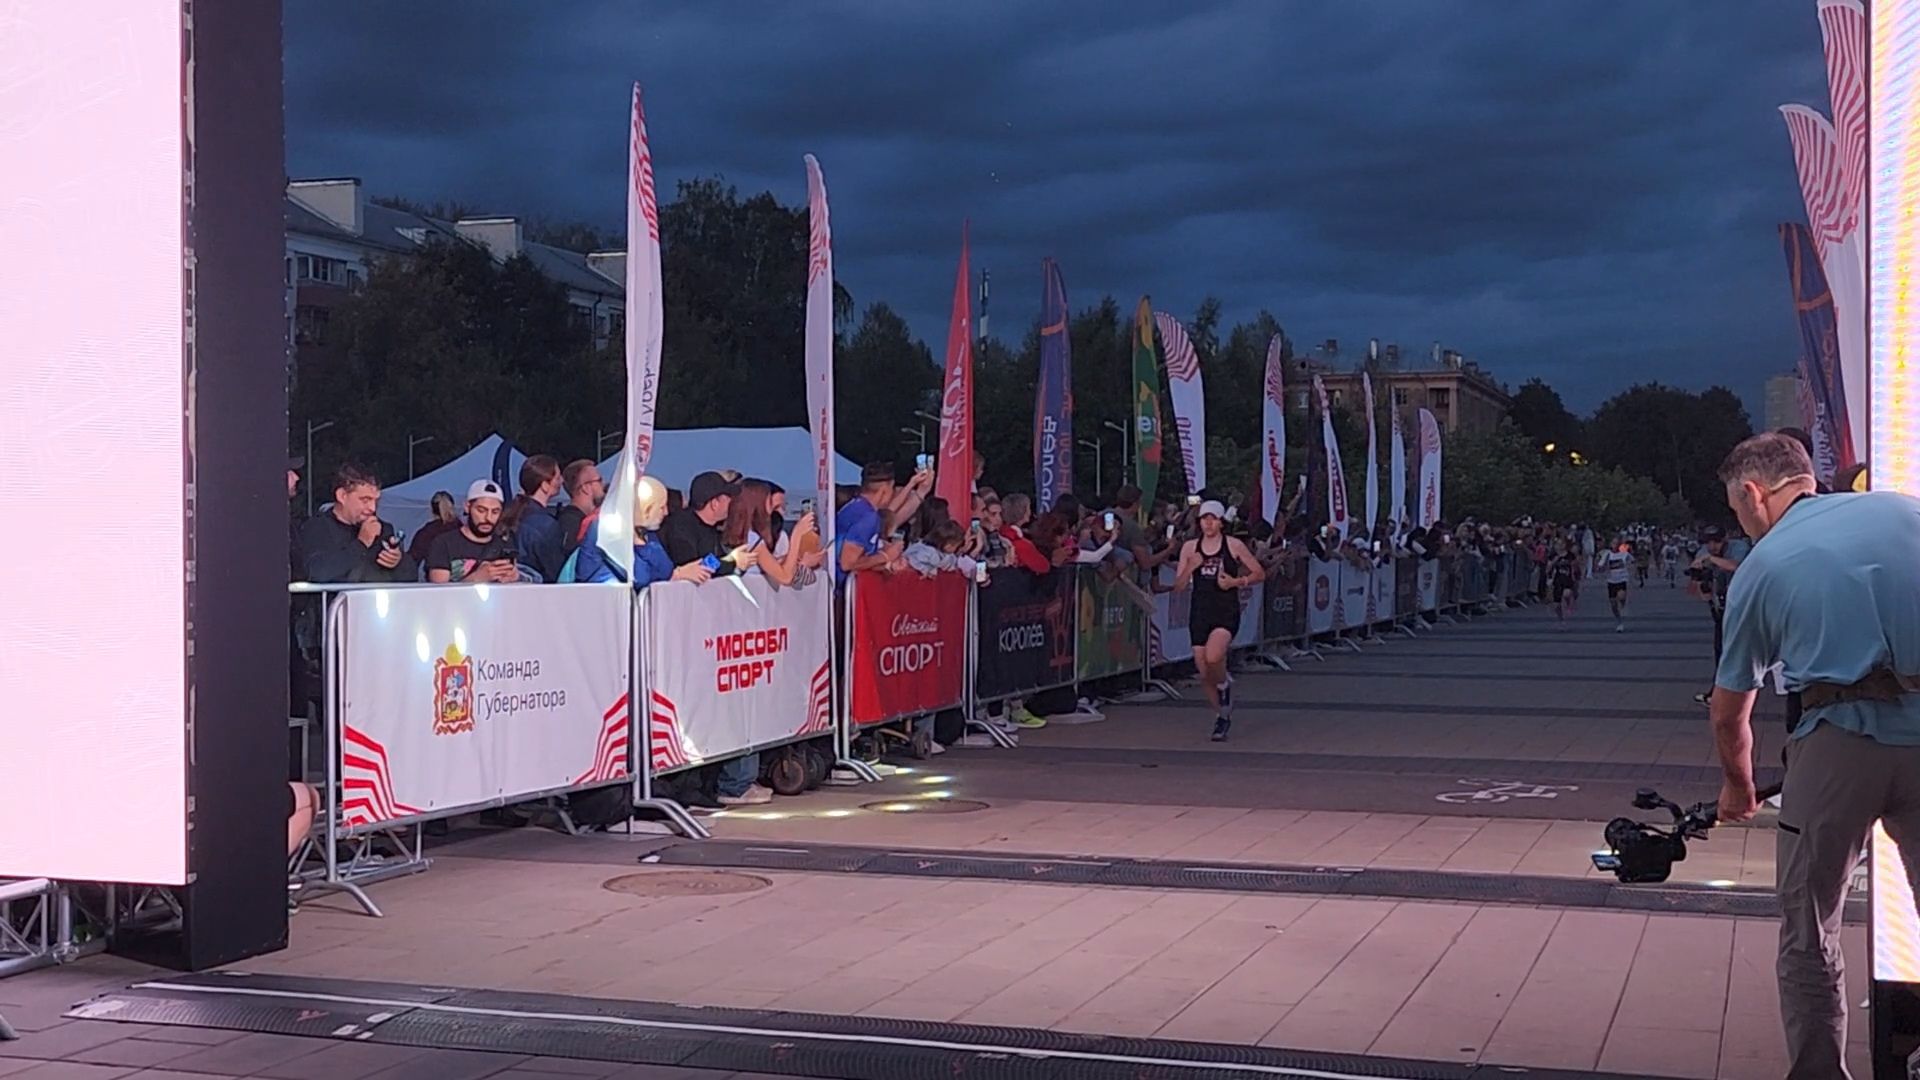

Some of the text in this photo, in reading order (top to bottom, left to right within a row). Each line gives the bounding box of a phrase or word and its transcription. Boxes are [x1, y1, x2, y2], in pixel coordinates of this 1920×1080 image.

[716, 627, 788, 662] МОСОБЛ
[879, 640, 945, 676] СПОРТ
[477, 659, 540, 681] Команда
[717, 659, 774, 693] СПОРТ
[477, 689, 567, 720] Губернатора
